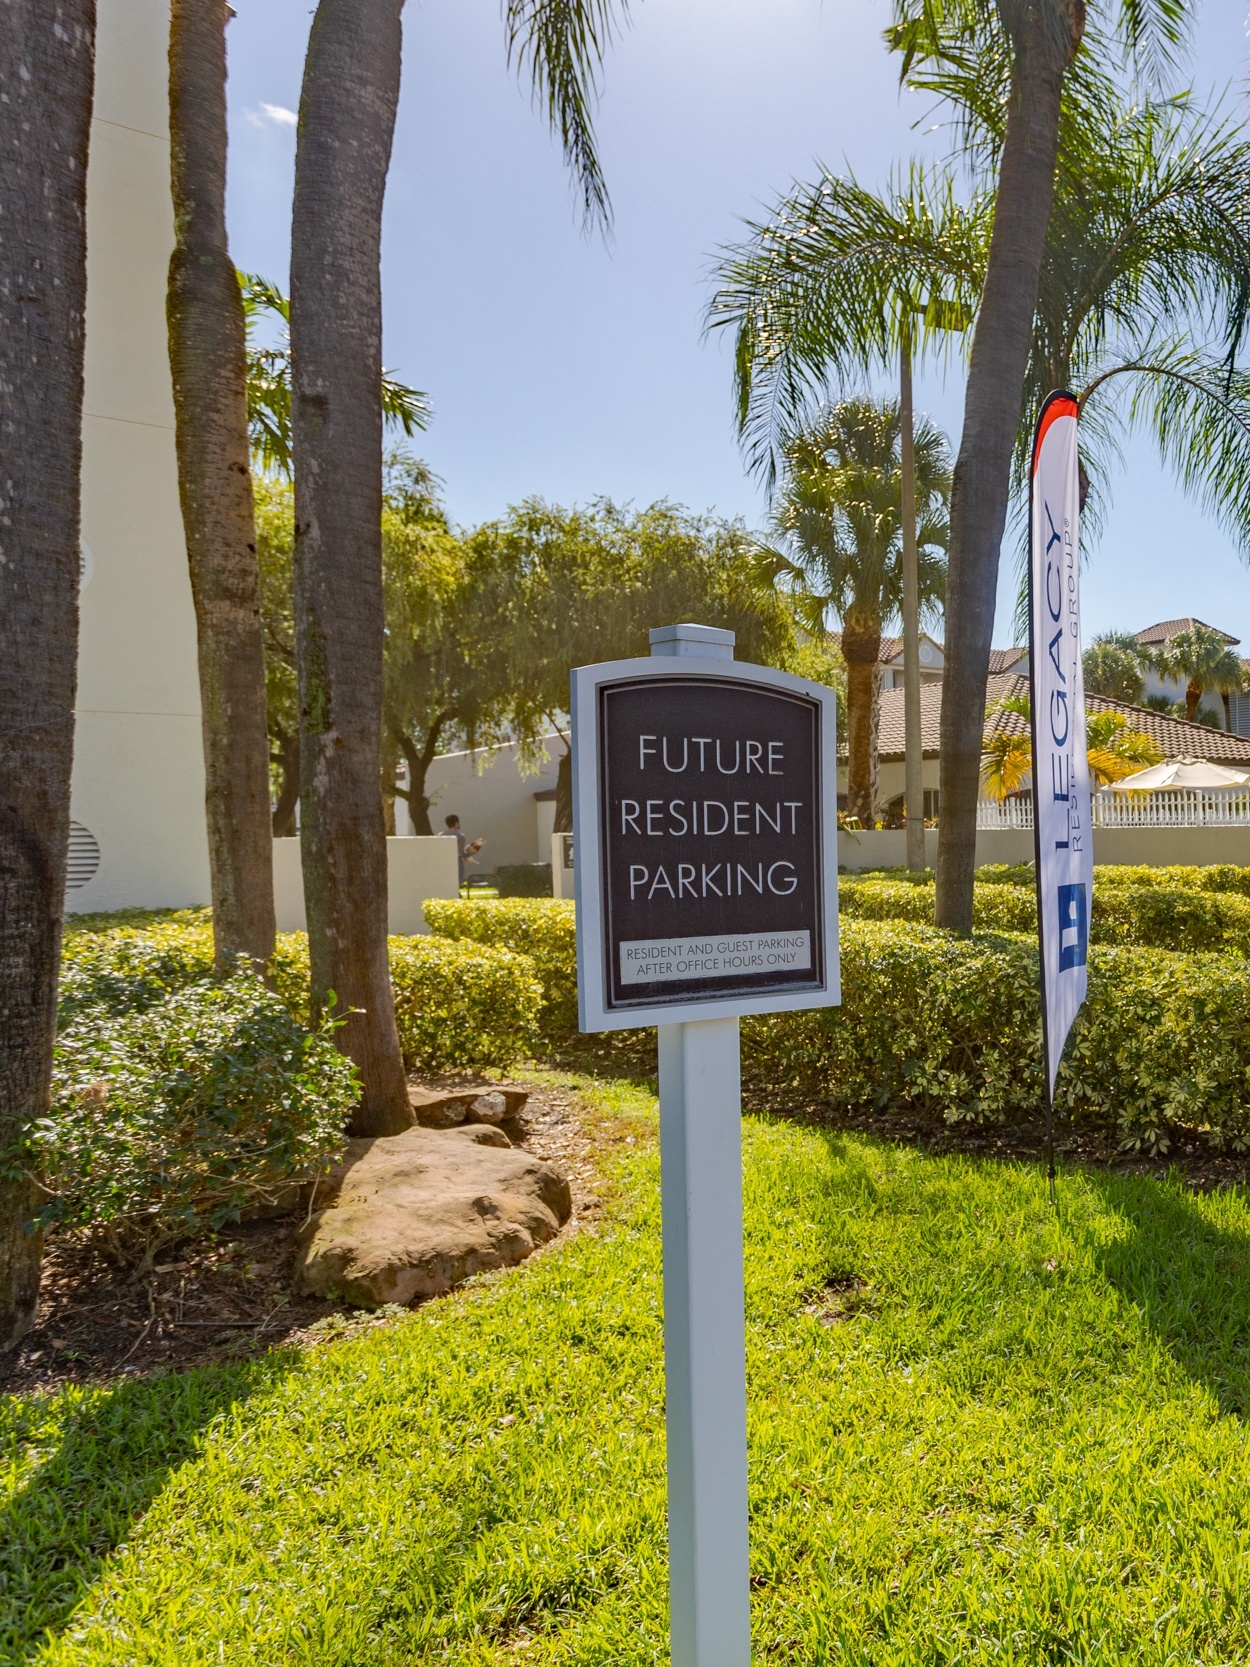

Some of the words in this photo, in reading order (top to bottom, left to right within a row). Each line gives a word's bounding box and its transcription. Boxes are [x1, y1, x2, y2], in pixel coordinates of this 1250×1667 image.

[1045, 499, 1069, 852] LEGACY
[639, 735, 784, 775] FUTURE
[621, 799, 803, 836] RESIDENT
[629, 861, 798, 900] PARKING
[627, 945, 684, 960] RESIDENT
[686, 943, 713, 956] AND
[717, 940, 754, 953] GUEST
[758, 937, 805, 950] PARKING
[636, 962, 673, 975] AFTER
[676, 958, 719, 973] OFFICE
[723, 955, 763, 969] HOURS
[767, 952, 797, 965] ONLY
